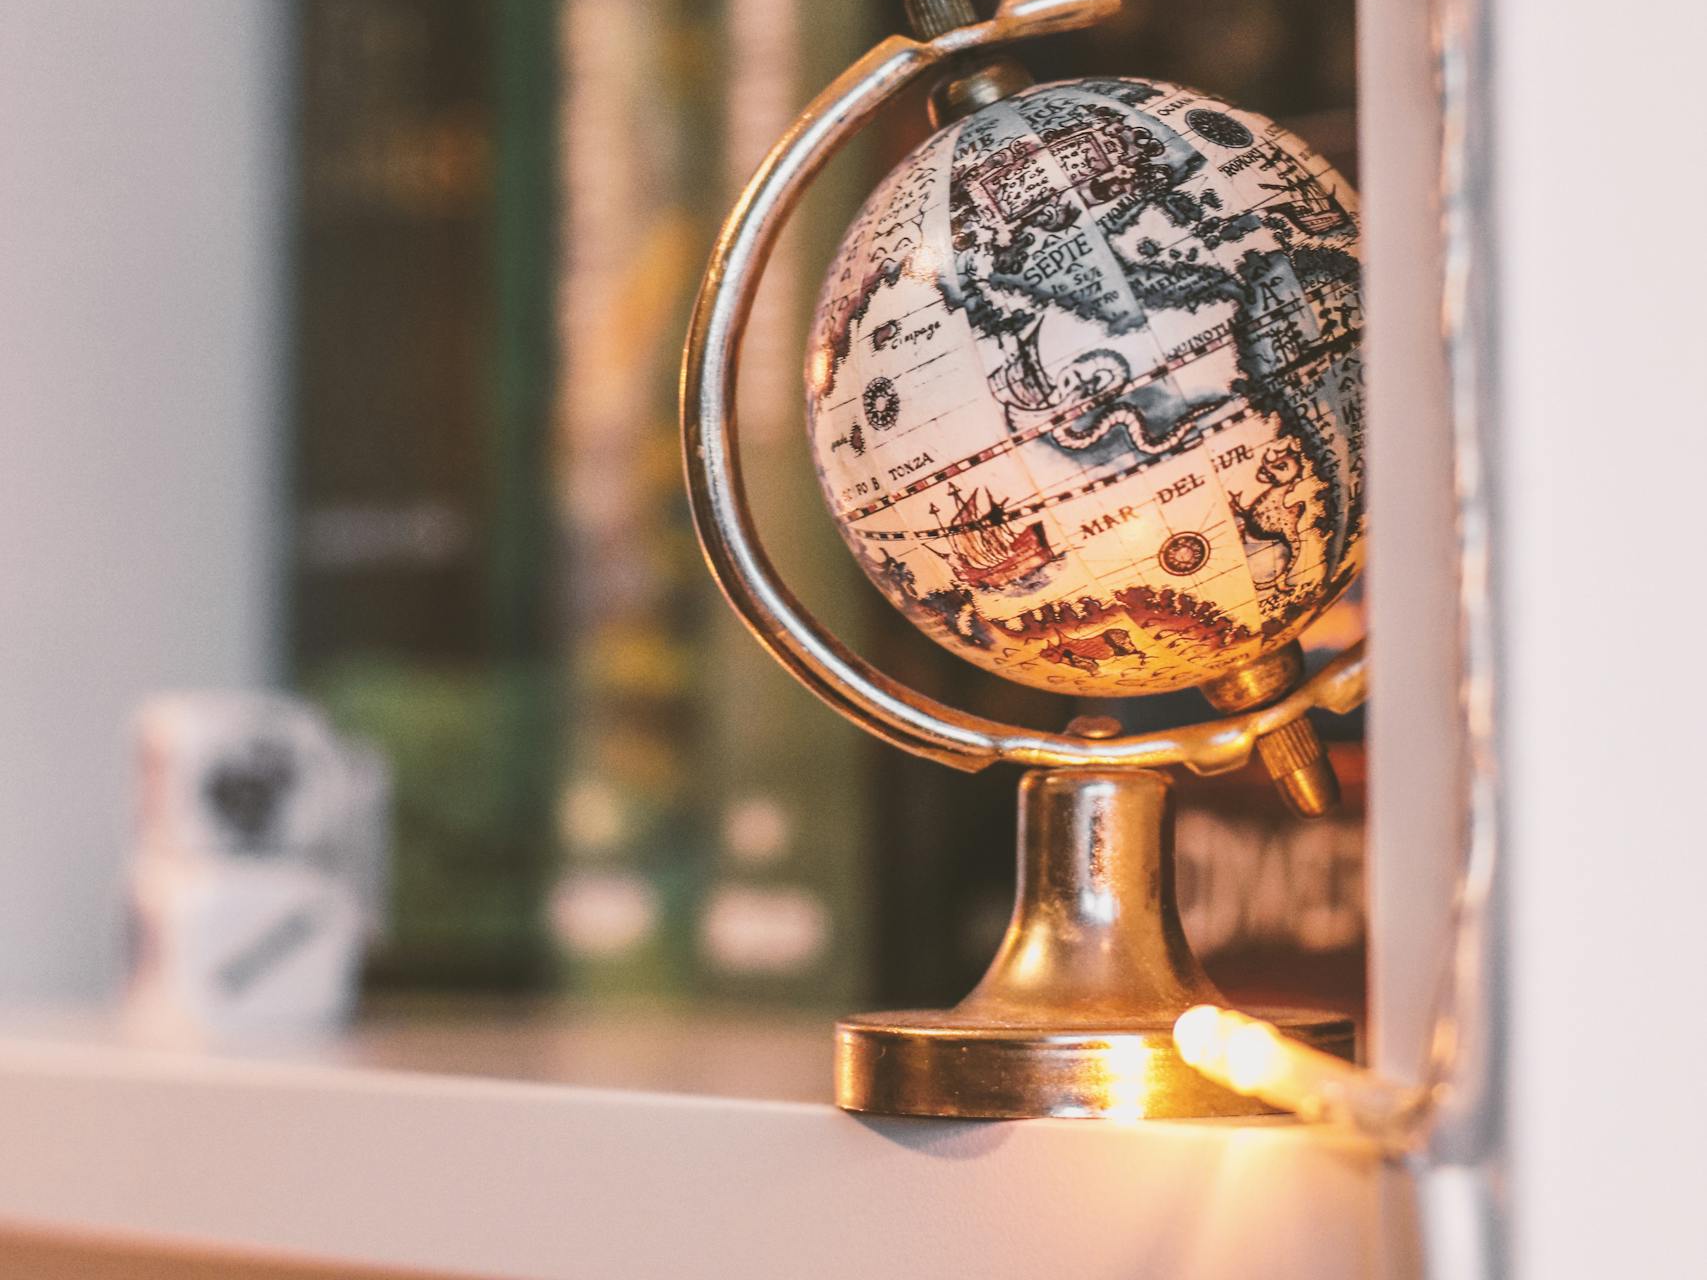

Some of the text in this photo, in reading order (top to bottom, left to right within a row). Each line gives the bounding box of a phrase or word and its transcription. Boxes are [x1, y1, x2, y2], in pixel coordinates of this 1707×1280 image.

[1023, 232, 1094, 288] SEPTE
[1079, 504, 1140, 540] MAR
[1155, 473, 1206, 505] DEL
